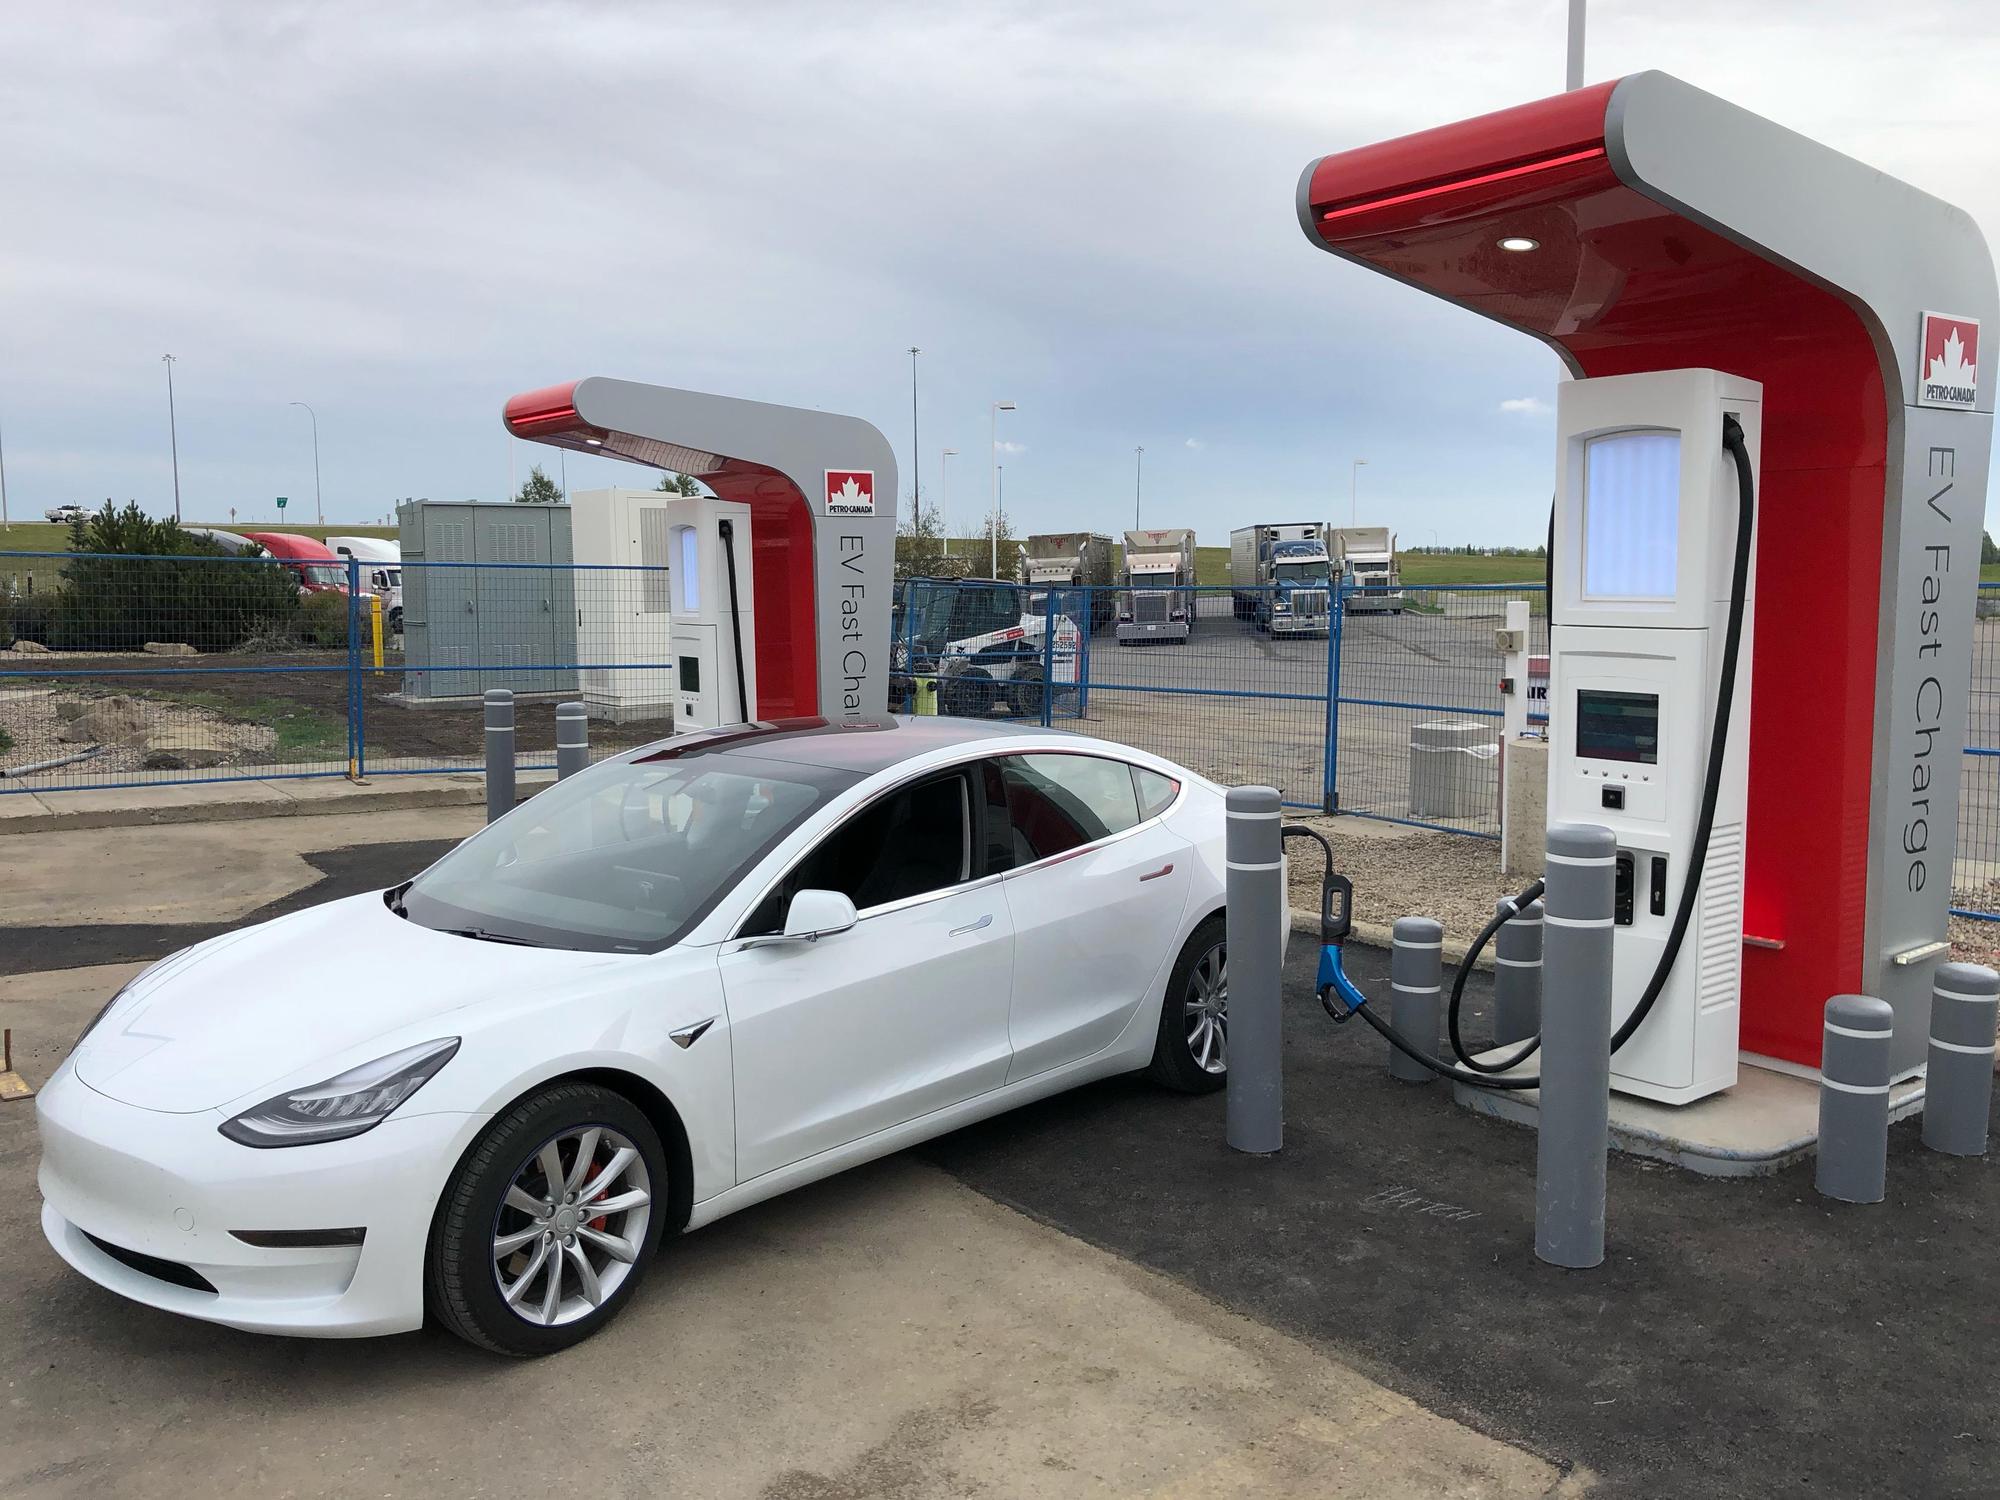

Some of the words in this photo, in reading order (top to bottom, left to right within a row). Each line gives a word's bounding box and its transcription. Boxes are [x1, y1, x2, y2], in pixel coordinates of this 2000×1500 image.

[1927, 447, 1955, 523] EV
[840, 536, 864, 574] EV
[842, 585, 865, 642] Fast
[1919, 544, 1949, 659] Fast
[1903, 677, 1942, 893] Charge
